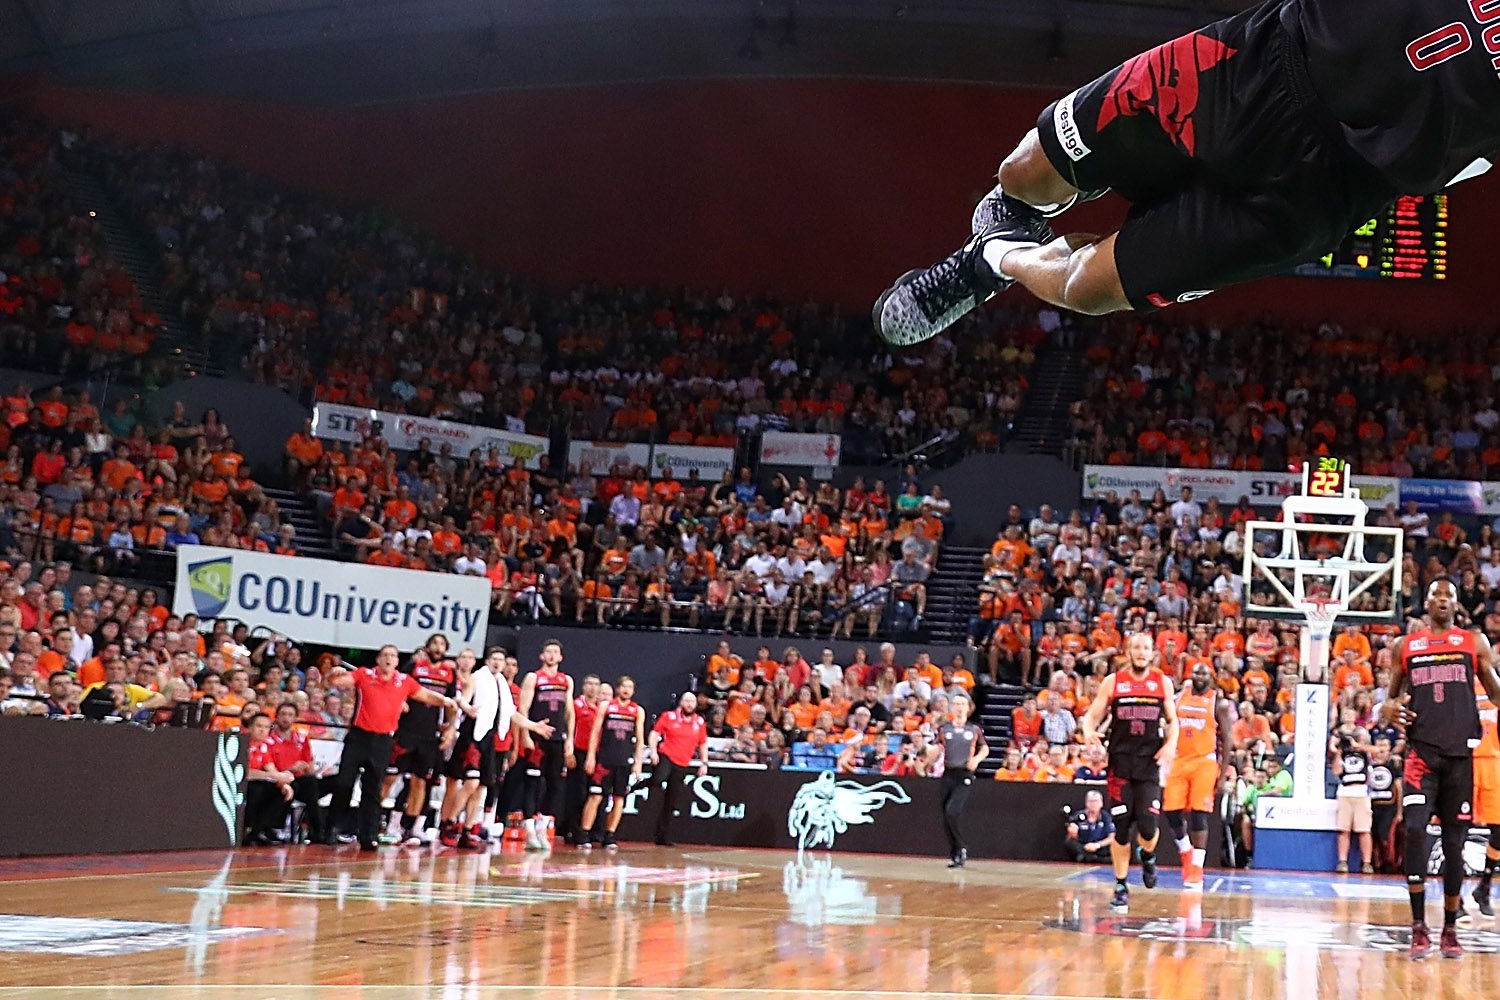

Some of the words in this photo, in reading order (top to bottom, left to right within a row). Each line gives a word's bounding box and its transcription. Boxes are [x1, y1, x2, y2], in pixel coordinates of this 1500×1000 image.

[1405, 21, 1473, 71] 0
[1311, 471, 1340, 496] 22
[237, 573, 481, 643] CQUniversity
